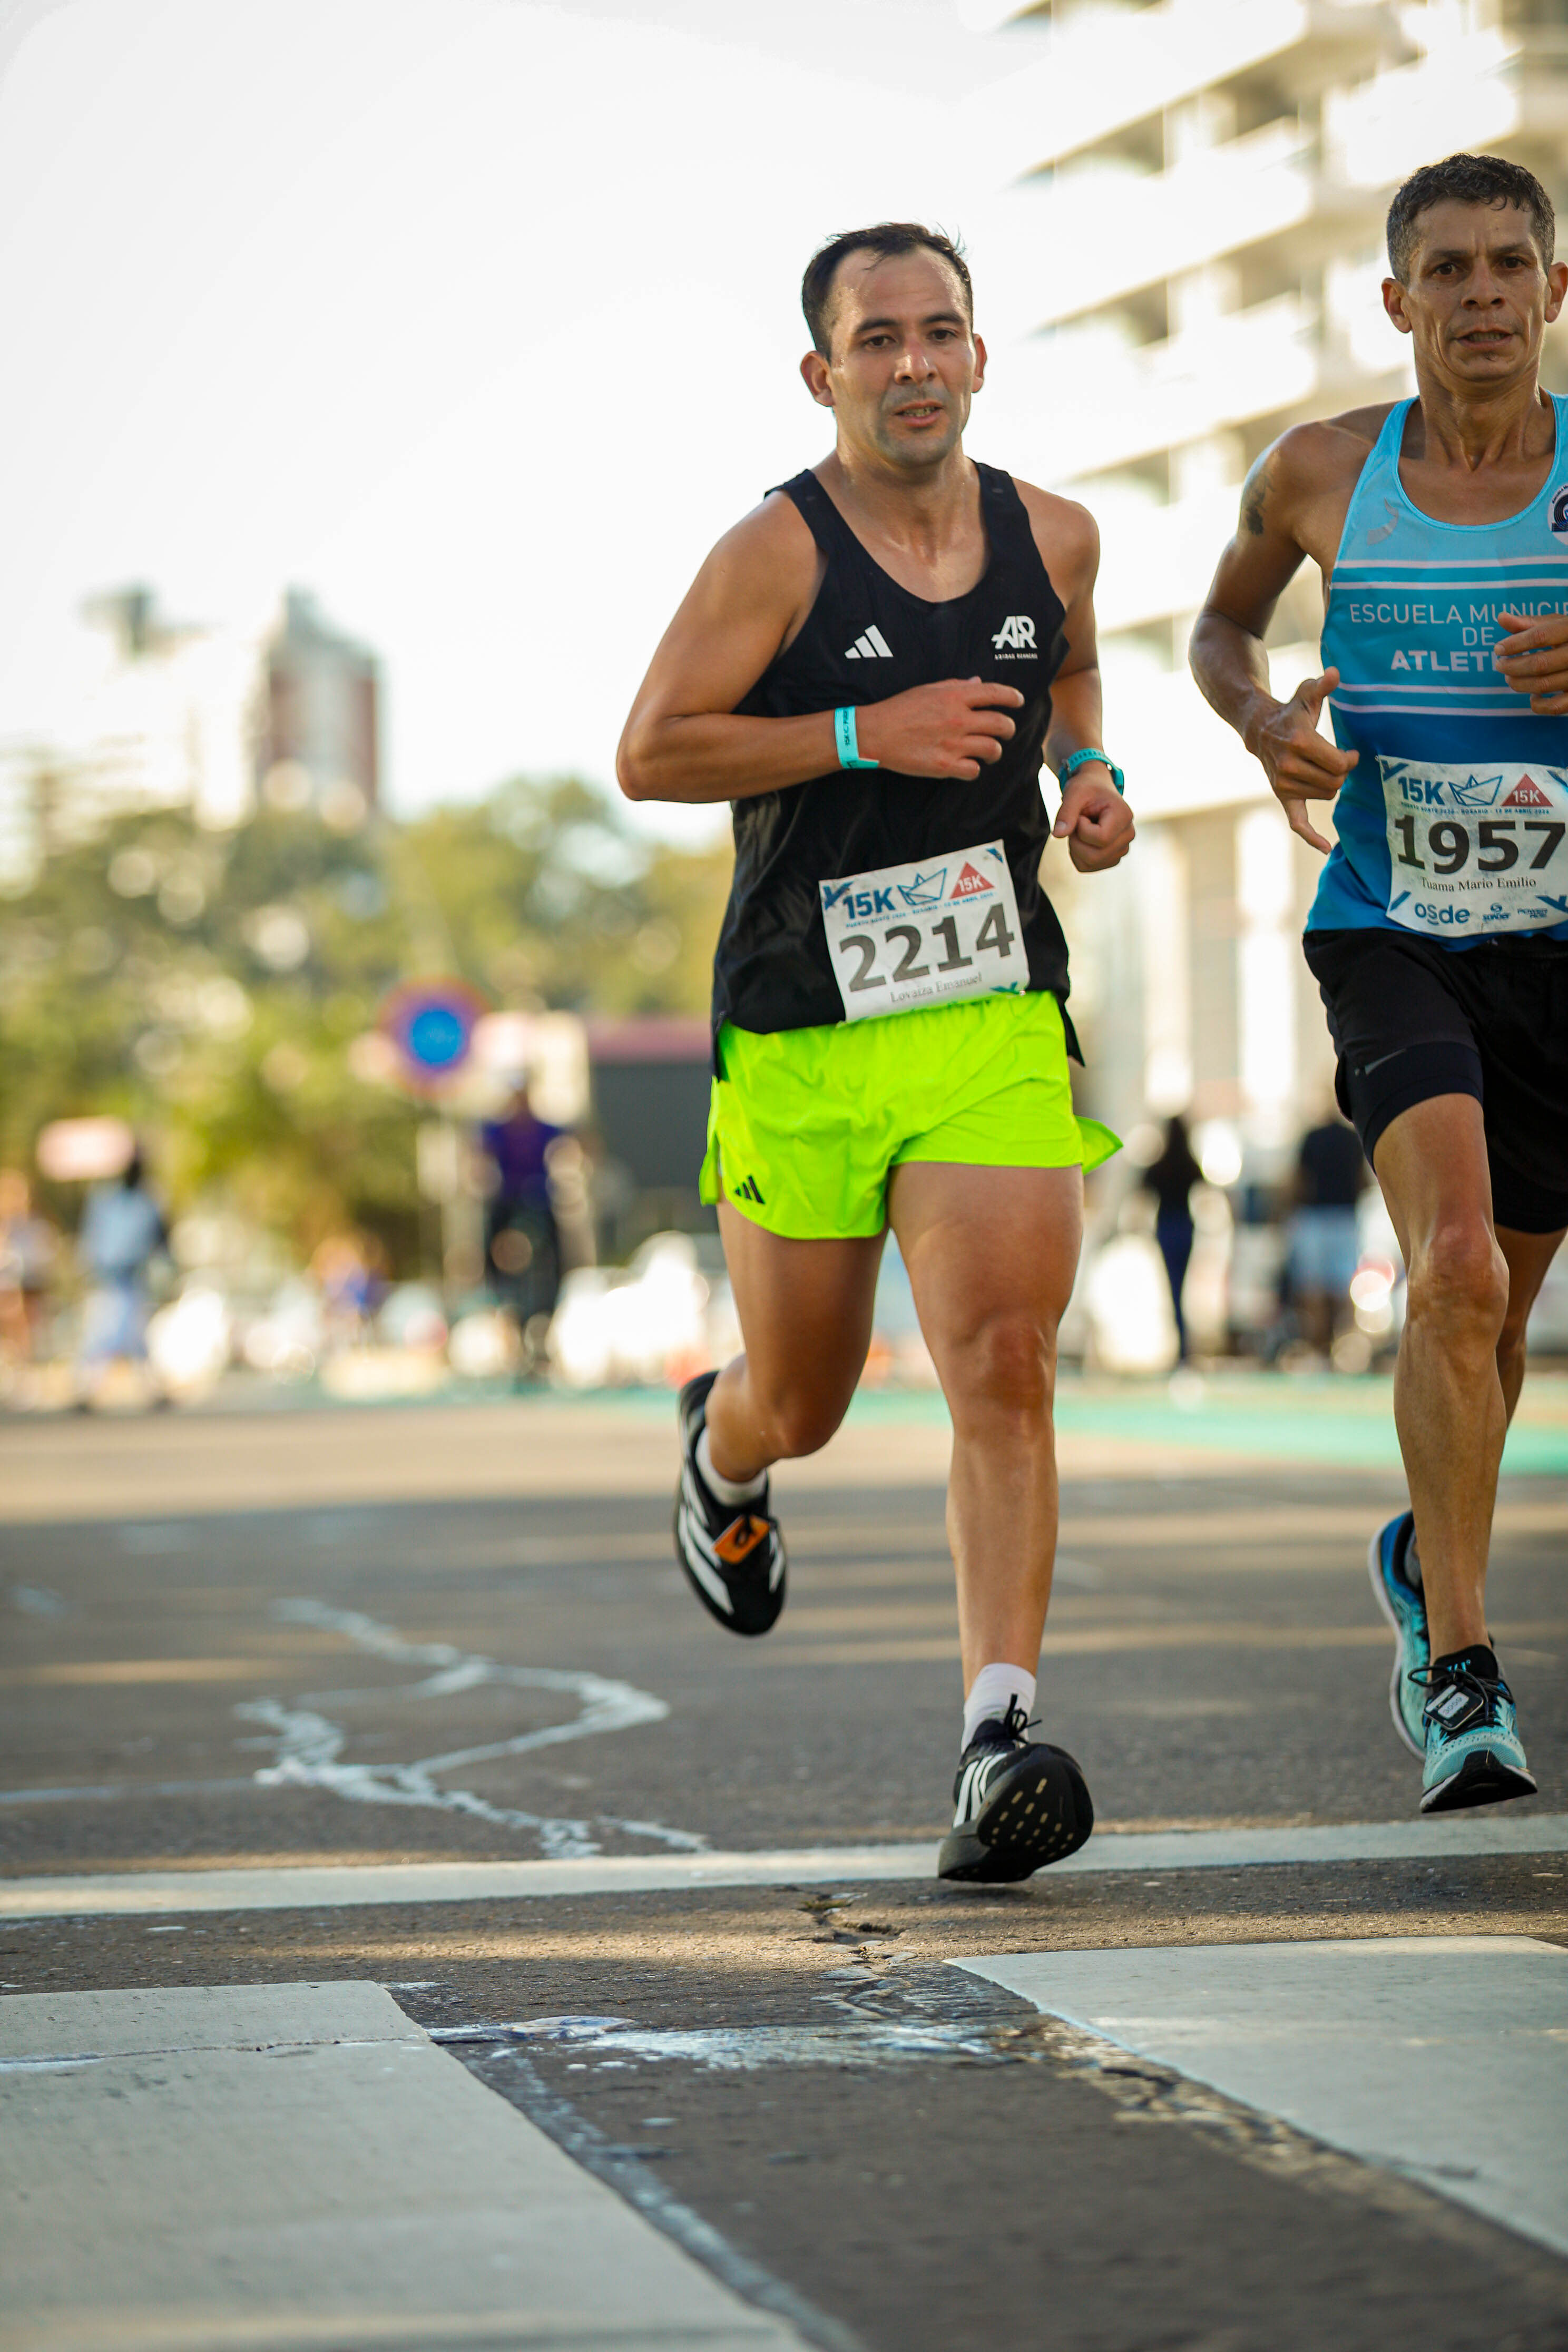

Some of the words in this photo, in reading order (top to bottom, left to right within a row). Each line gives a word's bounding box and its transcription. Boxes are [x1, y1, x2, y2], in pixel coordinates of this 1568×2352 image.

[1350, 603, 1463, 624] ESCUELA
[991, 615, 1038, 649] AR
[1463, 626, 1495, 646] DE
[1391, 650, 1544, 672] ATLETI
[1398, 775, 1445, 805] 15K
[1512, 789, 1541, 804] 15K
[1394, 815, 1566, 875] 1957
[957, 874, 984, 893] 15K
[1420, 876, 1455, 892] Tuama
[1458, 877, 1493, 891] Mario
[1497, 876, 1536, 888] Emilio
[843, 886, 896, 919] 15K
[1414, 902, 1471, 925] osde
[839, 902, 1015, 993] 2214
[890, 986, 934, 1003] Lovaiza
[935, 971, 982, 992] Emanuel
